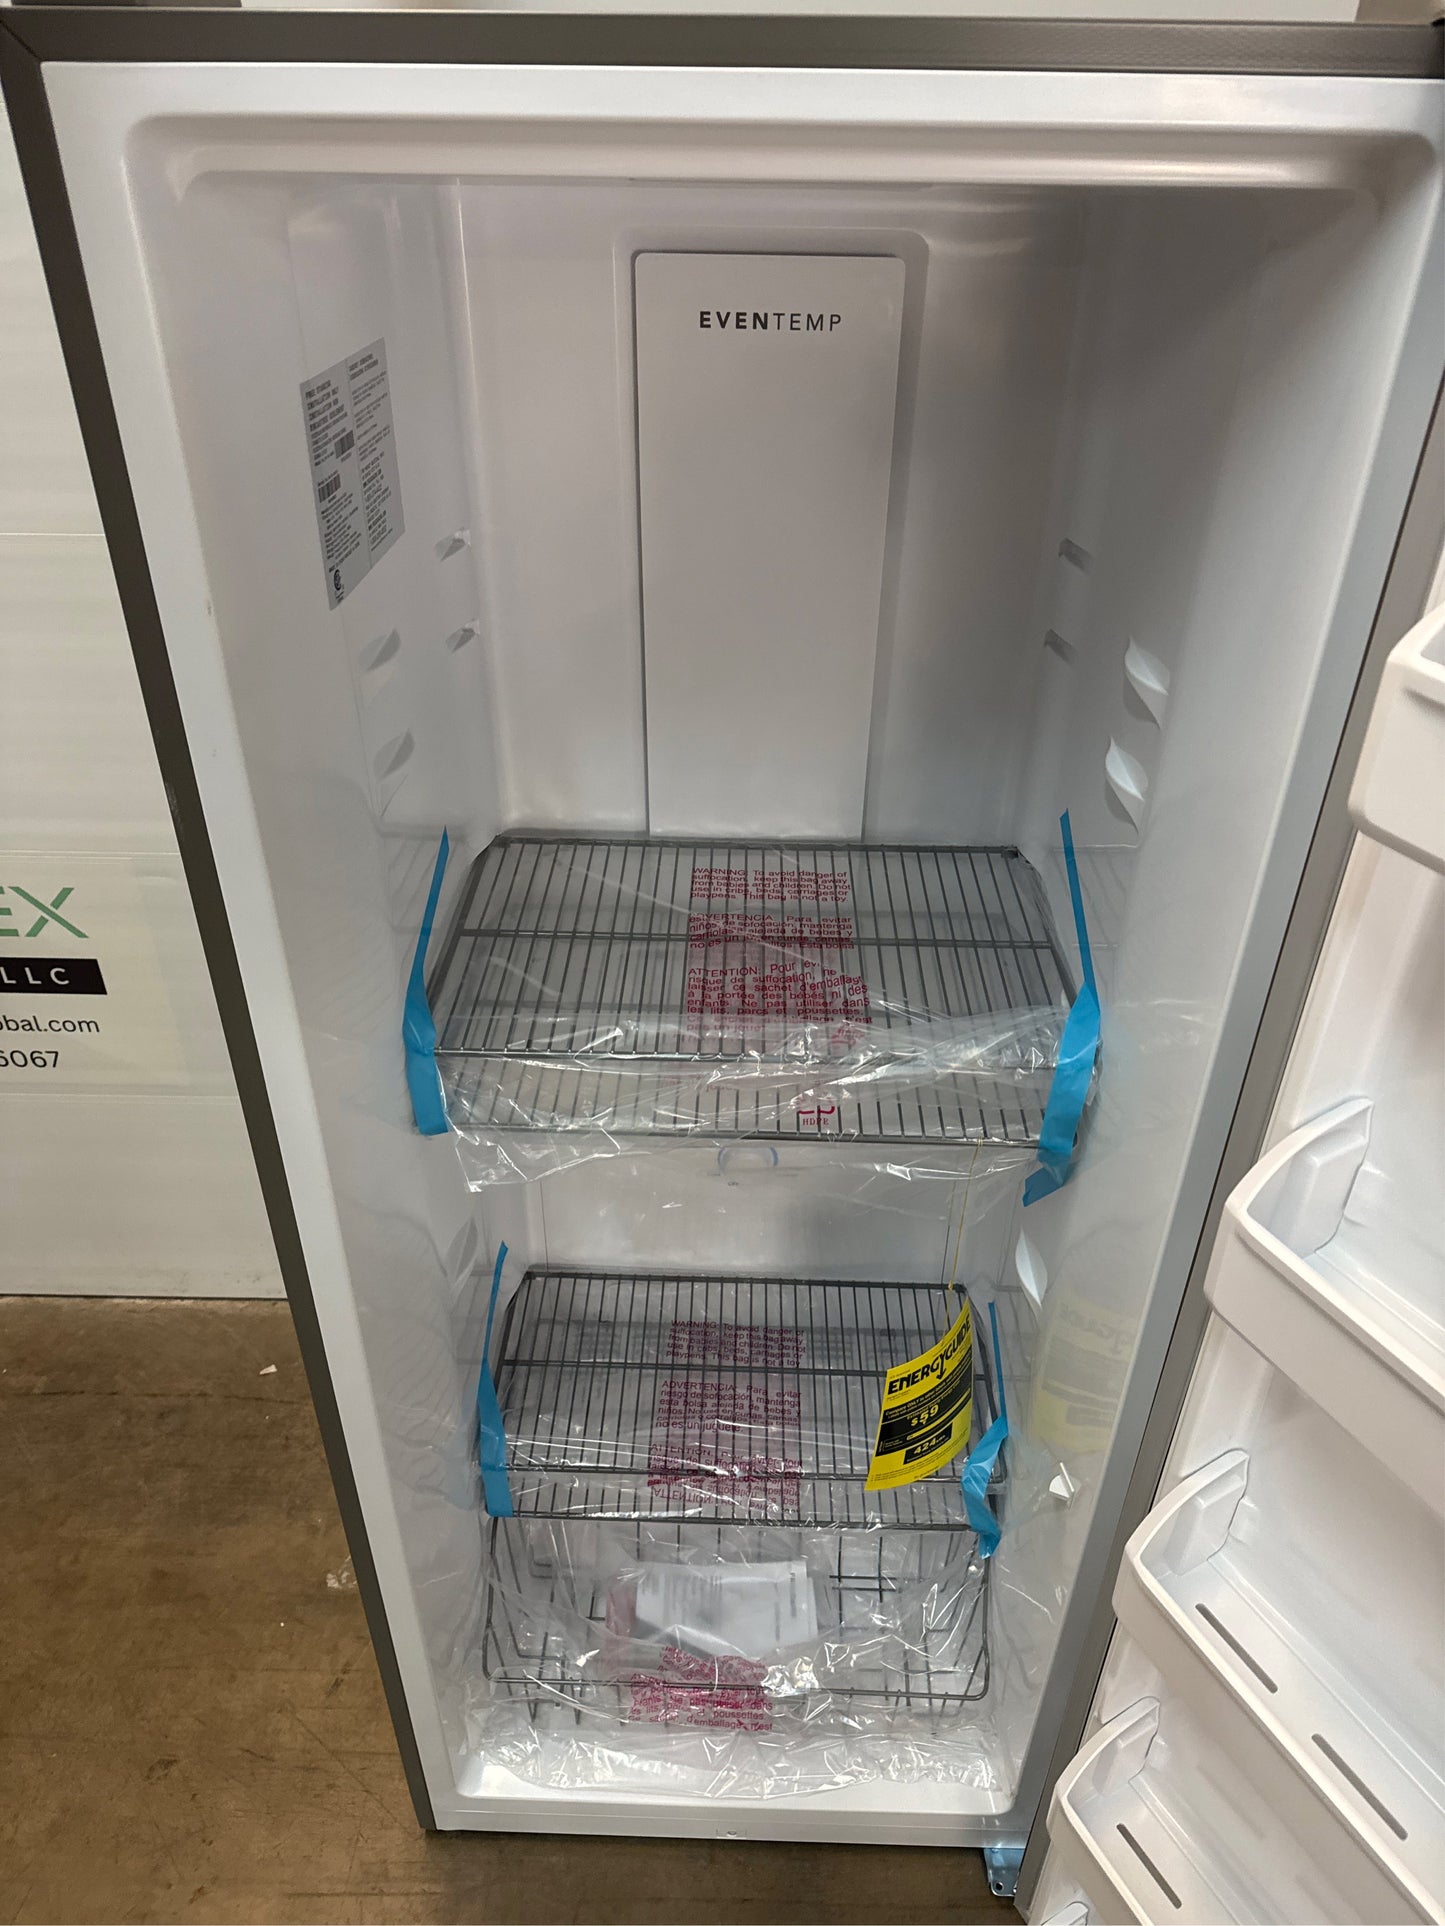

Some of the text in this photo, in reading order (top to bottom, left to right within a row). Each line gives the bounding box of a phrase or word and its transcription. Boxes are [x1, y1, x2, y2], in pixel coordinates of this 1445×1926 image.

[699, 311, 841, 331] EVENTEMP
[799, 870, 834, 879] danger
[768, 894, 786, 902] bag
[707, 938, 721, 947] es
[770, 962, 796, 973] Pour
[688, 976, 721, 985] risque
[752, 971, 815, 983] suffocation,
[688, 982, 725, 992] laisser
[754, 983, 792, 992] sachet
[702, 991, 711, 999] la
[762, 992, 782, 1000] des
[832, 988, 841, 999] ni
[848, 984, 868, 996] des
[766, 1000, 786, 1008] pas
[842, 997, 870, 1007] dans
[687, 1006, 704, 1014] les
[737, 1008, 769, 1016] parcs
[803, 1117, 829, 1126] HDPE
[911, 1405, 939, 1427] $59
[672, 1421, 684, 1429] es
[687, 1421, 700, 1430] un
[914, 1438, 936, 1455] 424
